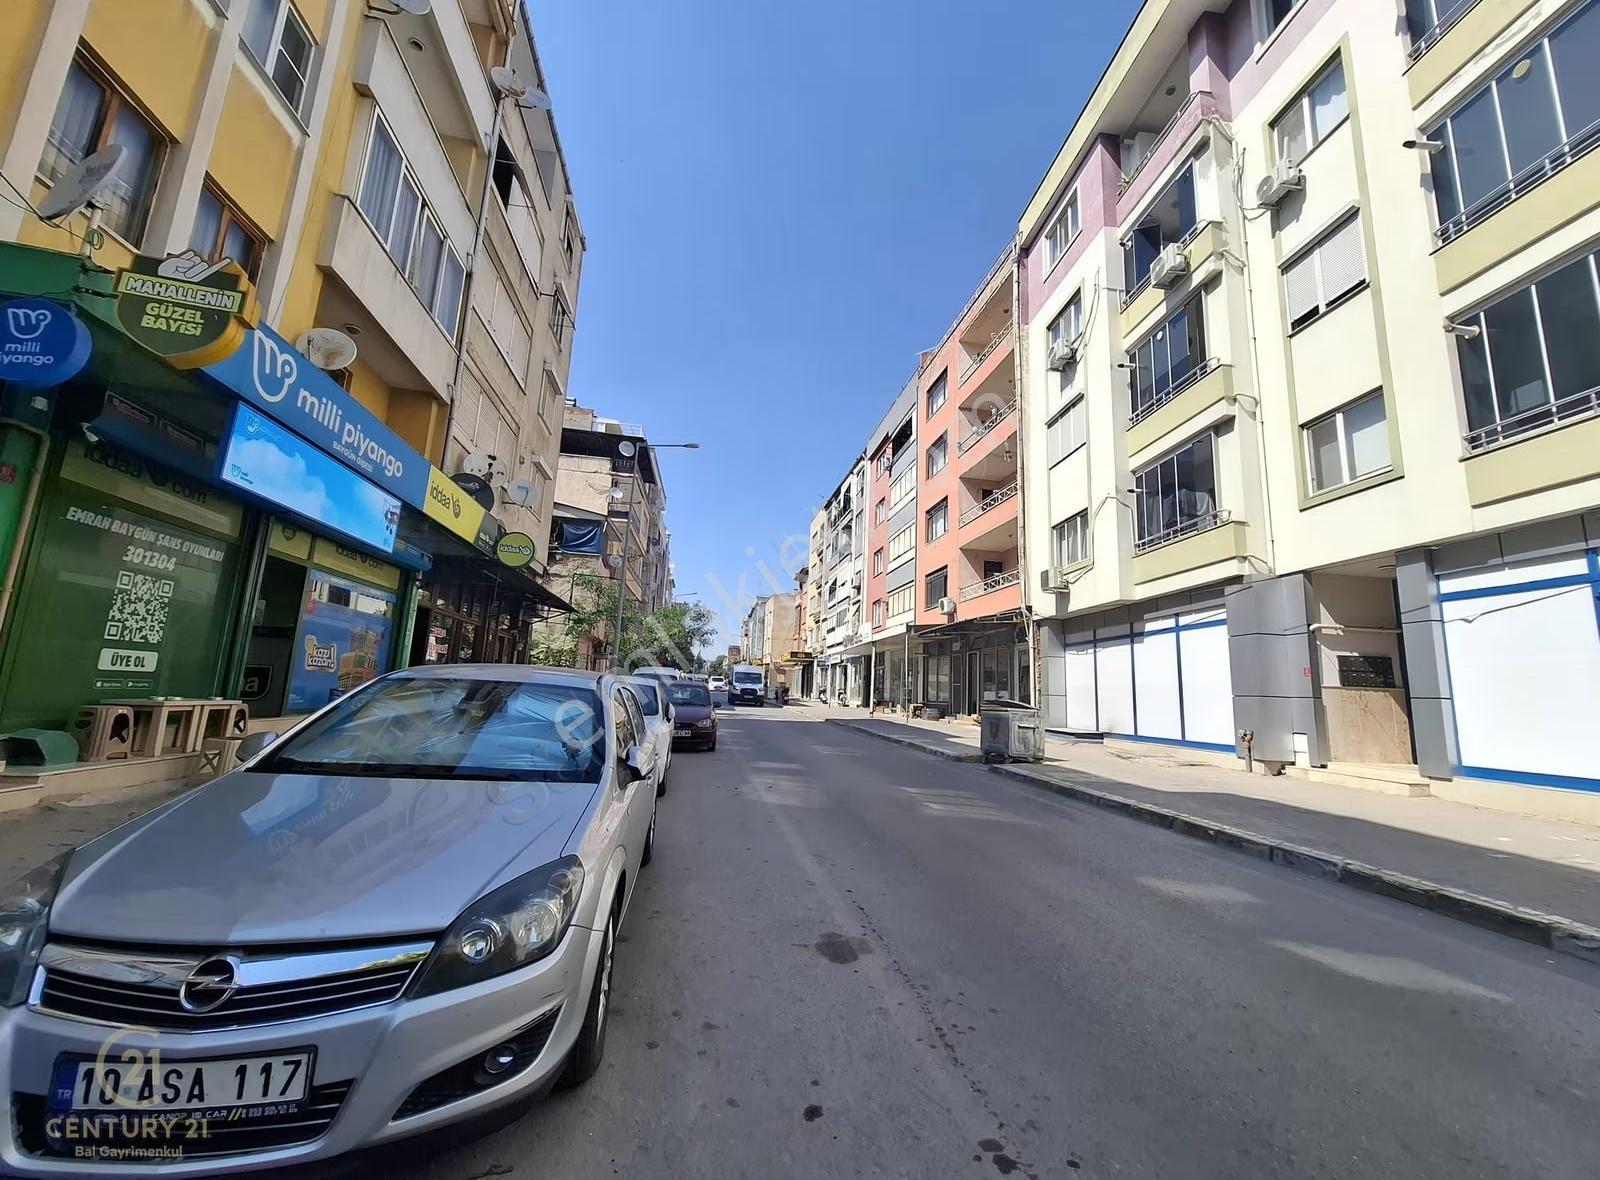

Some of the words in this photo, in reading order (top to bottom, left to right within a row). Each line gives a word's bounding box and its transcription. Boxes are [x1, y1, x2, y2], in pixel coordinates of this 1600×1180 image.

[126, 276, 235, 309] MAHALLENİN
[145, 301, 204, 323] GÜZEL
[140, 316, 203, 336] BAYİSİ
[4, 341, 40, 353] milli
[0, 351, 54, 366] iyango
[297, 387, 343, 433] milli
[342, 422, 403, 478] piyango
[430, 481, 451, 510] iddaa
[66, 506, 111, 530] EMRAH
[182, 541, 225, 562] OYUNLARI
[123, 545, 177, 571] 301304
[500, 544, 520, 553] iddaa
[111, 652, 133, 667] ÜYE
[133, 655, 146, 668] OL
[82, 1067, 121, 1104] 10
[137, 1066, 205, 1104] ASA
[235, 1058, 302, 1100] 117
[56, 1088, 73, 1100] TR
